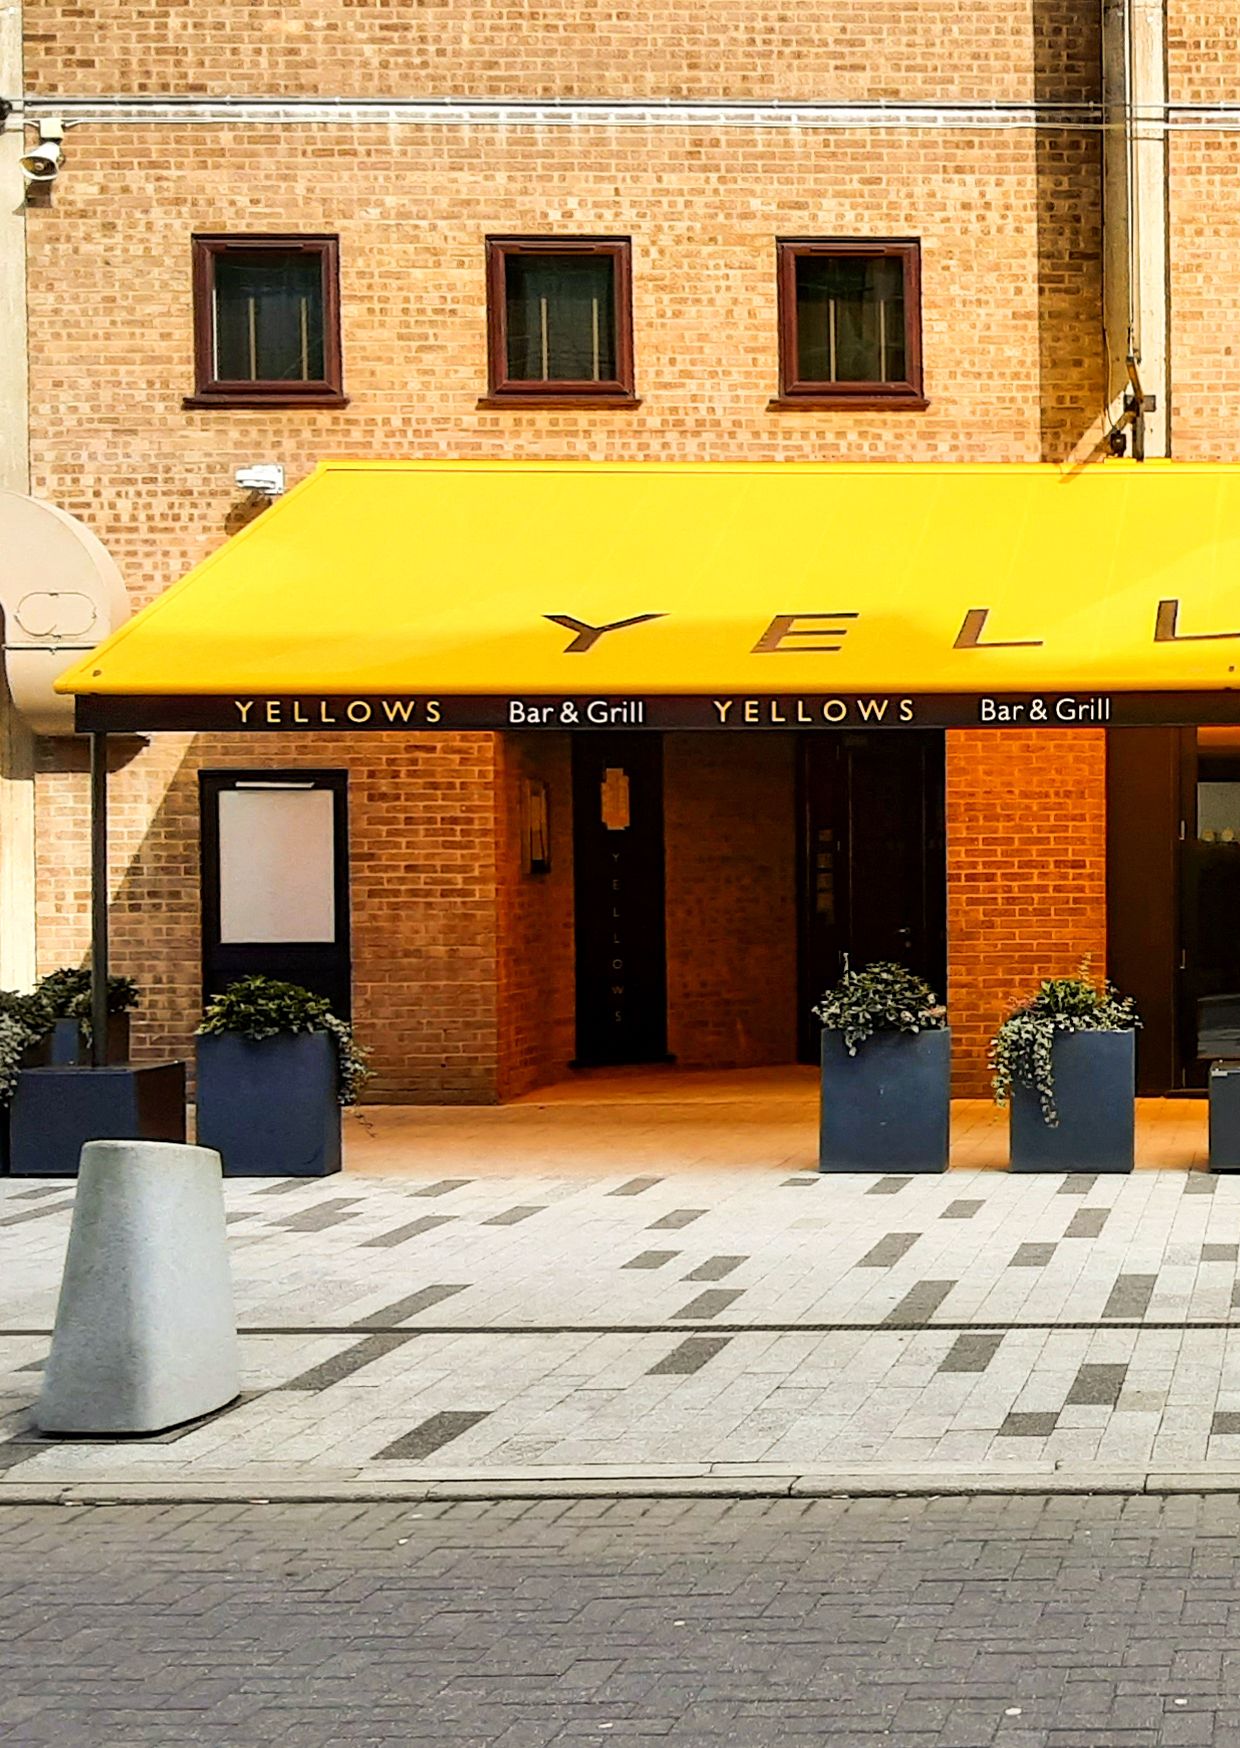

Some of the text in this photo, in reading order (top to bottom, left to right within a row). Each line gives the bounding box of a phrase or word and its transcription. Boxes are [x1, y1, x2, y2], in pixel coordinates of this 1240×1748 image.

[234, 697, 1111, 724] YELLOWS Bar & Grill YELLOWS Bar & Grill
